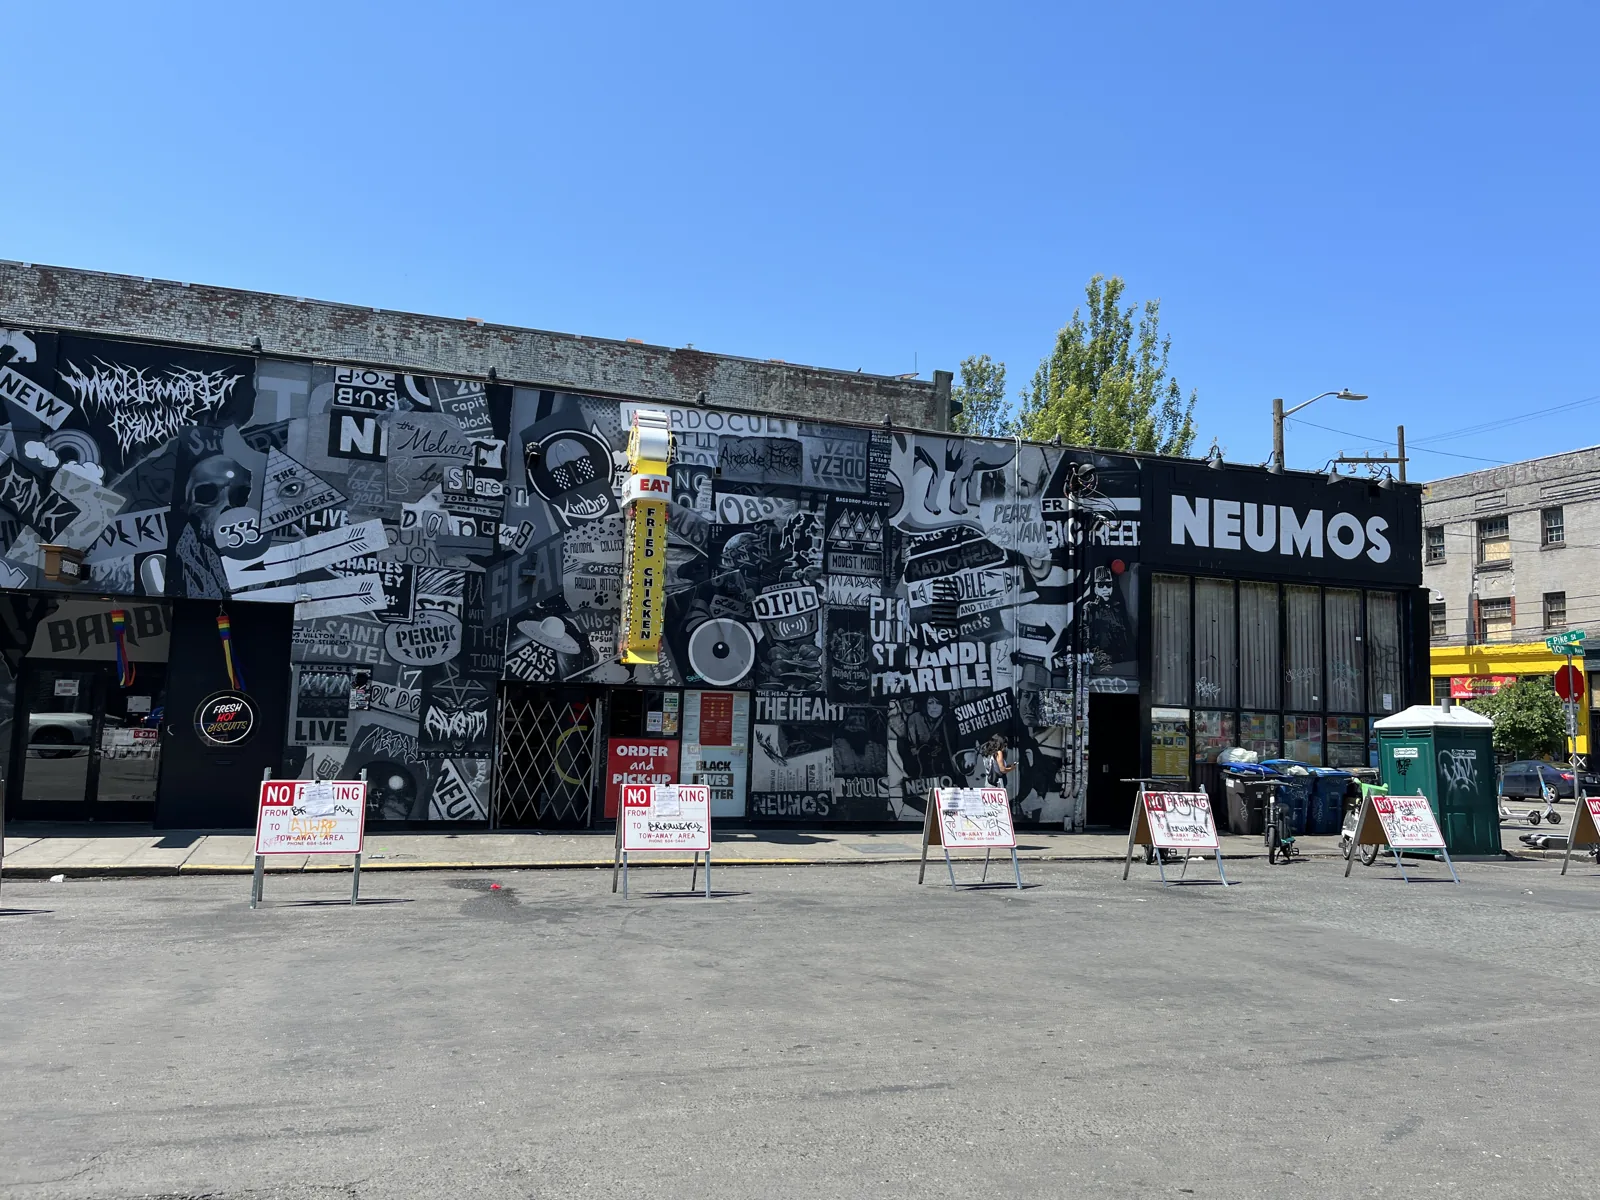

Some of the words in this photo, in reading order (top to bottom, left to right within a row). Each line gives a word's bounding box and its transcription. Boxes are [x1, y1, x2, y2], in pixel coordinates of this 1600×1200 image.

[1, 372, 64, 418] NEW
[458, 411, 492, 430] block
[272, 467, 297, 482] THE
[639, 479, 671, 494] EAT
[268, 491, 335, 526] LUMINEERS
[553, 493, 610, 527] Kimbra
[993, 504, 1034, 523] PEARL
[310, 509, 349, 527] LIVE
[219, 518, 262, 548] 33
[645, 507, 655, 557] FRIED
[1171, 494, 1392, 564] NEUMOS
[832, 554, 857, 568] MODEST
[640, 567, 653, 640] CHICKEN
[960, 605, 977, 615] AND
[979, 600, 994, 609] THE
[326, 621, 384, 645] SAINT
[396, 624, 457, 648] PERCK
[1553, 635, 1568, 645] Pike
[312, 643, 393, 667] MOTEL
[416, 646, 436, 660] UP
[532, 641, 553, 658] THE
[519, 645, 556, 676] BASS
[213, 702, 243, 716] FRESH
[216, 712, 236, 721] HOT
[755, 698, 787, 721] THE
[954, 703, 977, 722] SUN
[977, 696, 997, 717] OCT
[988, 704, 1014, 728] LIGHT
[207, 720, 248, 734] BISCUITS
[294, 720, 348, 742] LIVE
[616, 745, 669, 757] ORDER
[630, 757, 655, 771] and
[696, 760, 731, 772] BLACK
[266, 786, 291, 803] NO
[627, 788, 648, 804] NO
[1148, 794, 1163, 809] NO
[1167, 797, 1206, 808] PARKING
[264, 809, 289, 817] FROM
[1393, 800, 1427, 810] PARKING
[270, 823, 281, 831] TO
